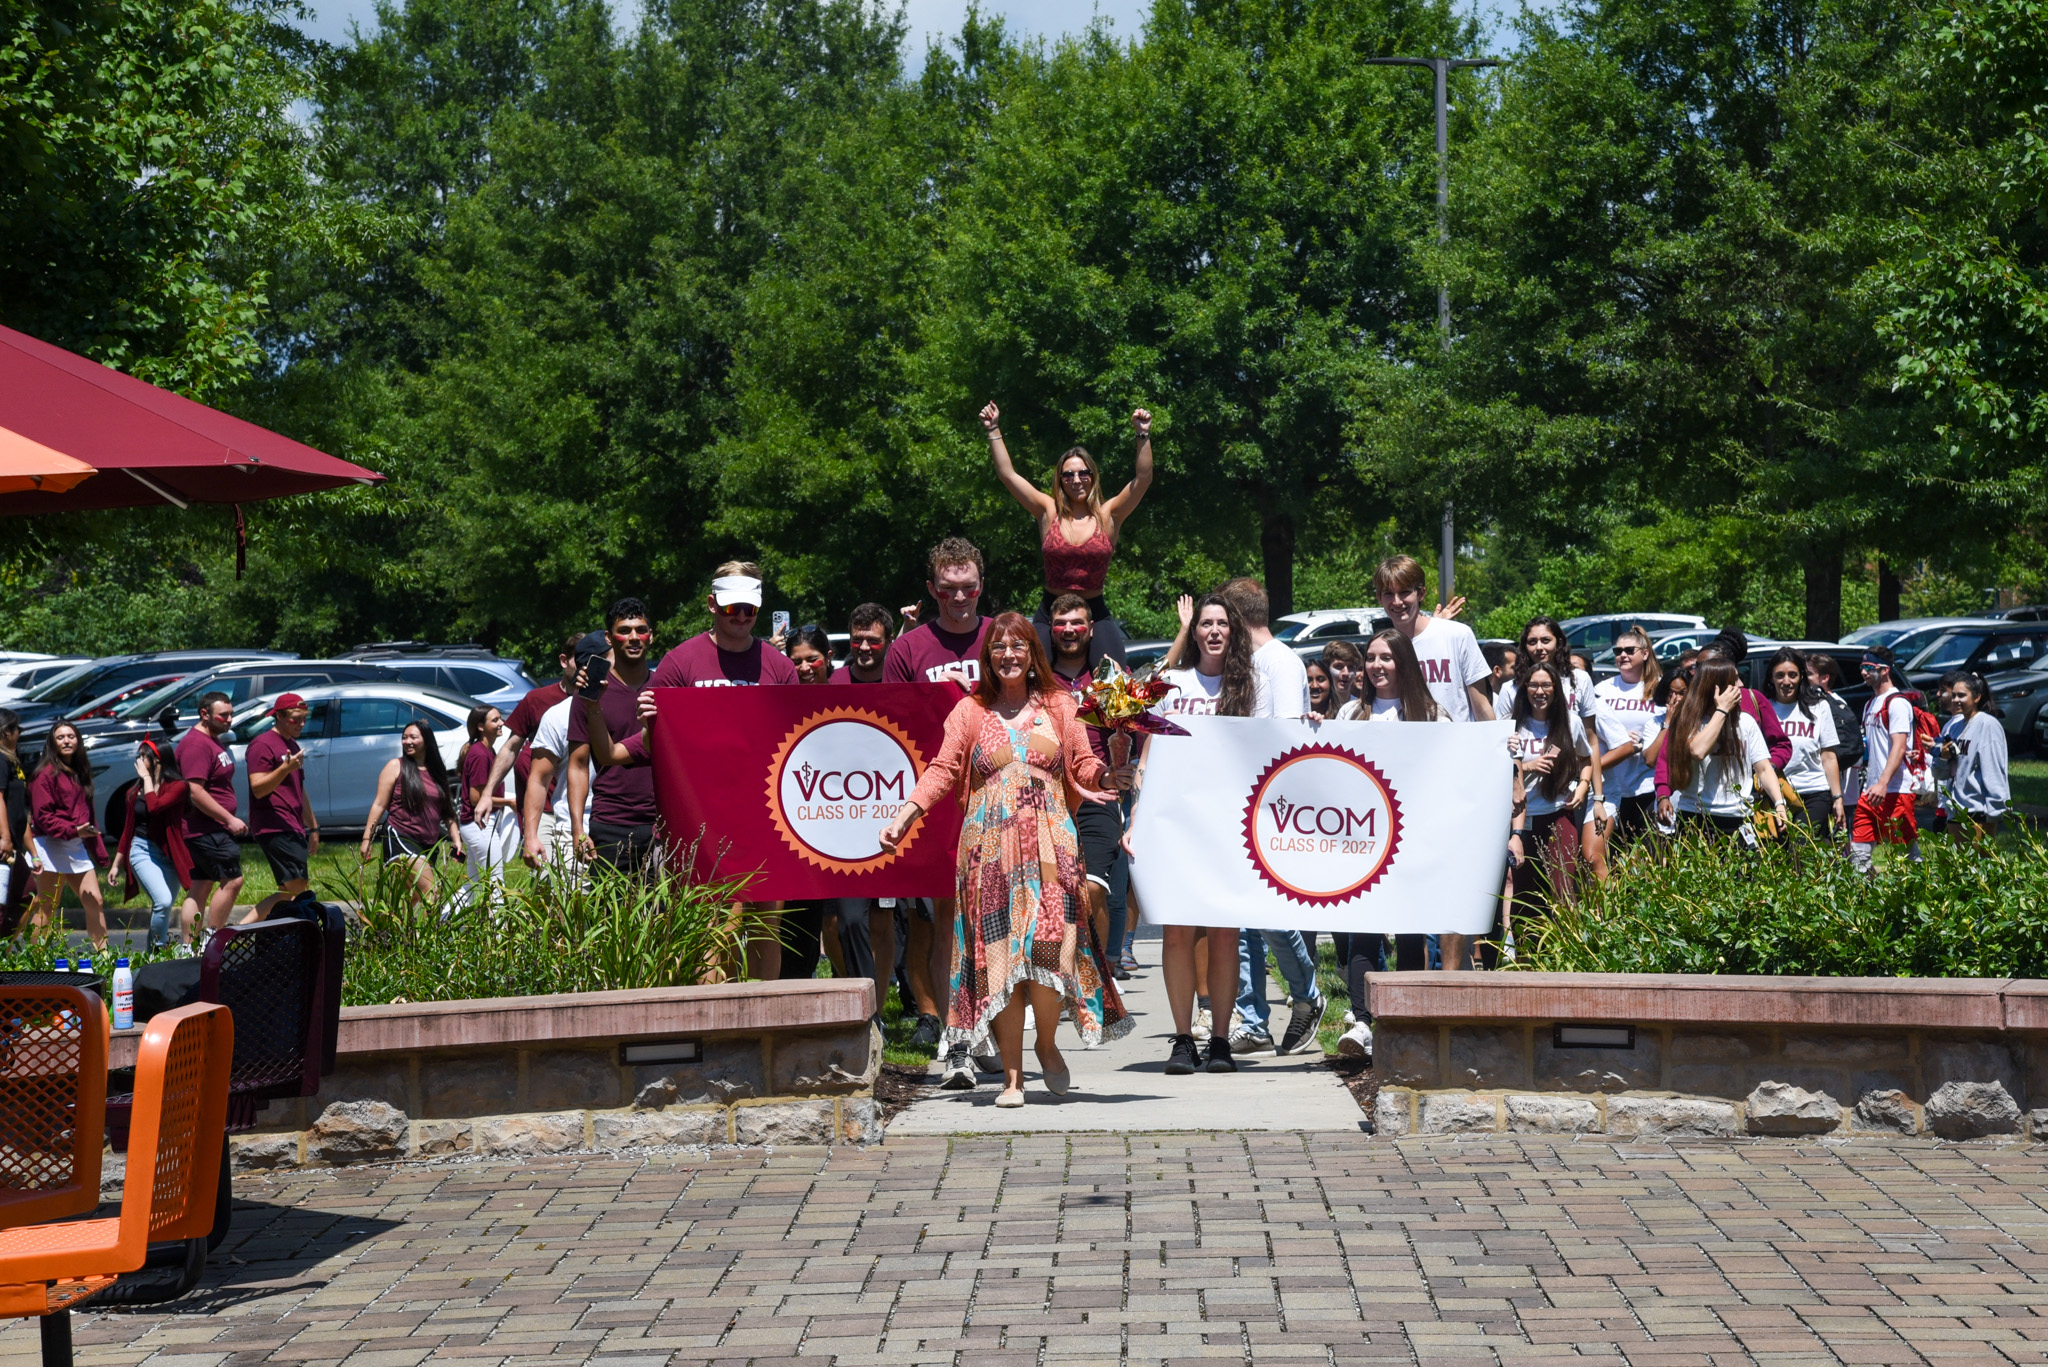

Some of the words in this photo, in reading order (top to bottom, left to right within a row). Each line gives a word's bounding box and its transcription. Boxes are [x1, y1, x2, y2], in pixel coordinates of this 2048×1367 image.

[792, 769, 905, 802] VCOM
[797, 804, 844, 820] CLASS
[849, 804, 867, 819] OF
[1268, 802, 1376, 837] VCOM
[1270, 836, 1315, 853] CLASS
[1320, 838, 1337, 853] OF
[1342, 840, 1376, 855] 2027
